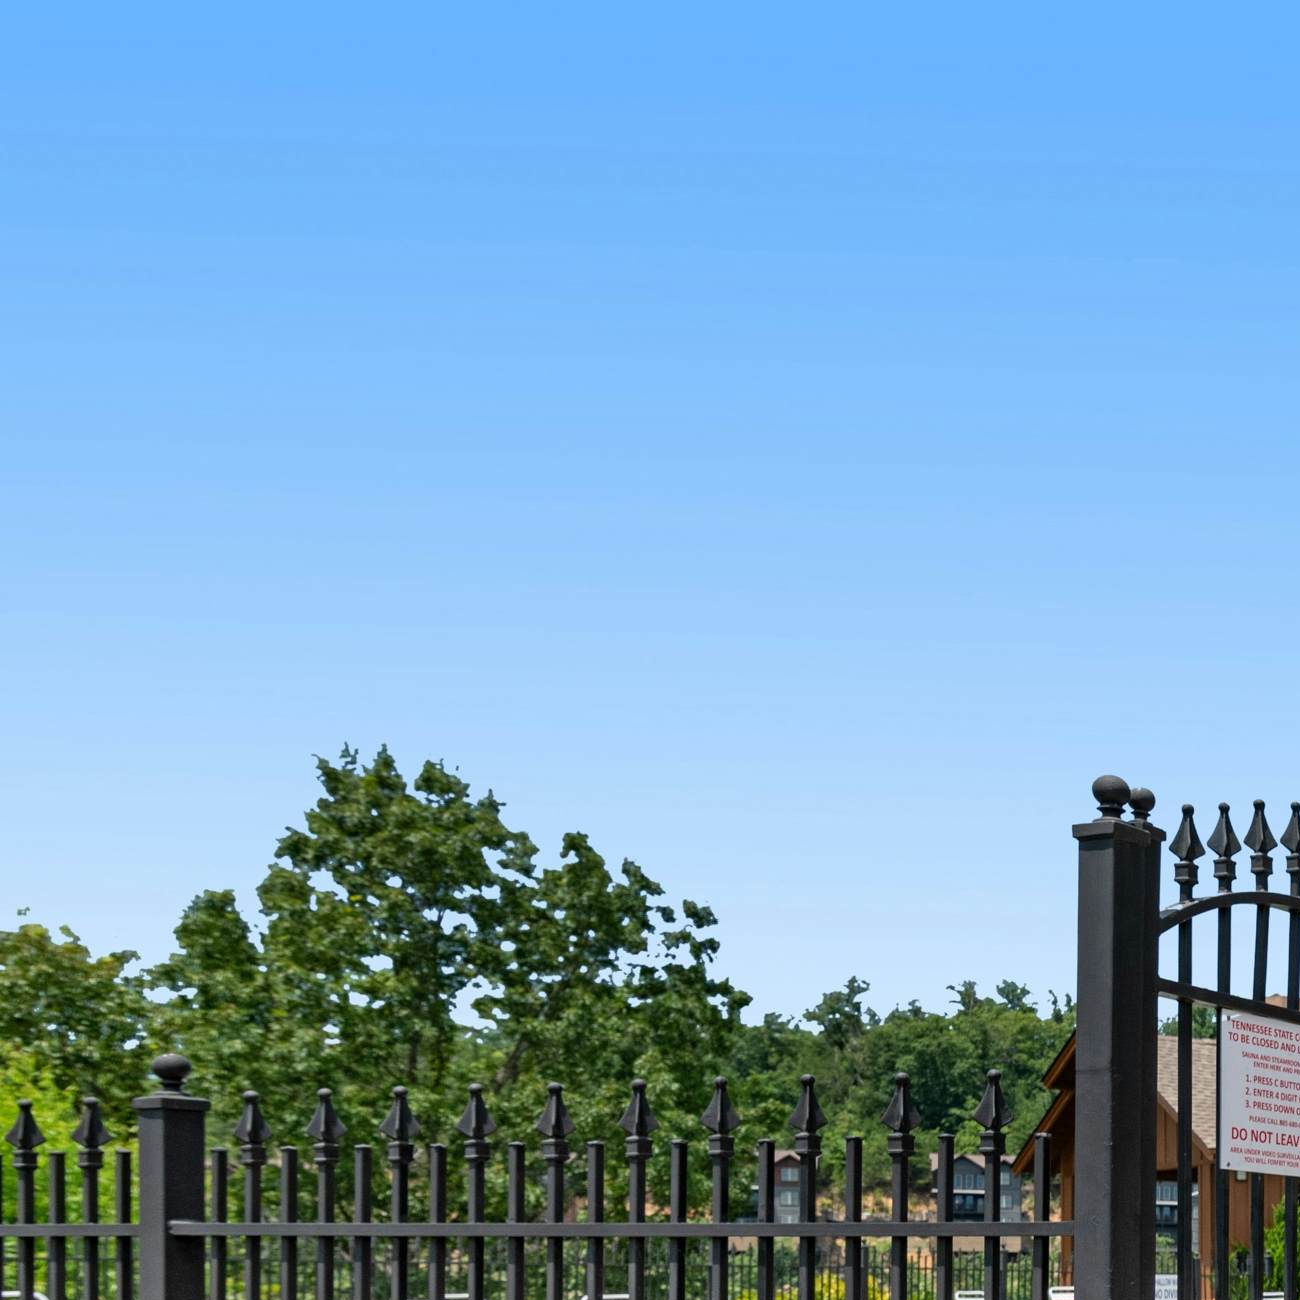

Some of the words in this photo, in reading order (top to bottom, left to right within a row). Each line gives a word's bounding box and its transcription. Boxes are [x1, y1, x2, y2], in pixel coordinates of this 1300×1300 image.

[1231, 1020, 1272, 1036] TENNESSEE
[1274, 1029, 1294, 1041] STATE
[1228, 1032, 1239, 1041] TO
[1241, 1034, 1250, 1044] BE
[1252, 1036, 1279, 1049] CLOSED
[1281, 1042, 1296, 1053] AND
[1254, 1061, 1269, 1069] ENTER
[1270, 1064, 1281, 1072] HERE
[1283, 1066, 1293, 1074] AND
[1246, 1074, 1252, 1083] 1.
[1253, 1075, 1273, 1087] PRESS
[1274, 1079, 1279, 1087] C
[1245, 1087, 1252, 1096] 2.
[1253, 1088, 1274, 1099] ENTER
[1275, 1092, 1280, 1100] 4
[1281, 1093, 1297, 1102] DIGIT
[1245, 1100, 1252, 1108] 3.
[1253, 1101, 1272, 1111] PRESS
[1274, 1104, 1295, 1115] DOWN
[1249, 1115, 1265, 1124] PLEASE
[1267, 1118, 1278, 1126] CALL
[1231, 1127, 1248, 1141] DO
[1251, 1130, 1273, 1144] NOT
